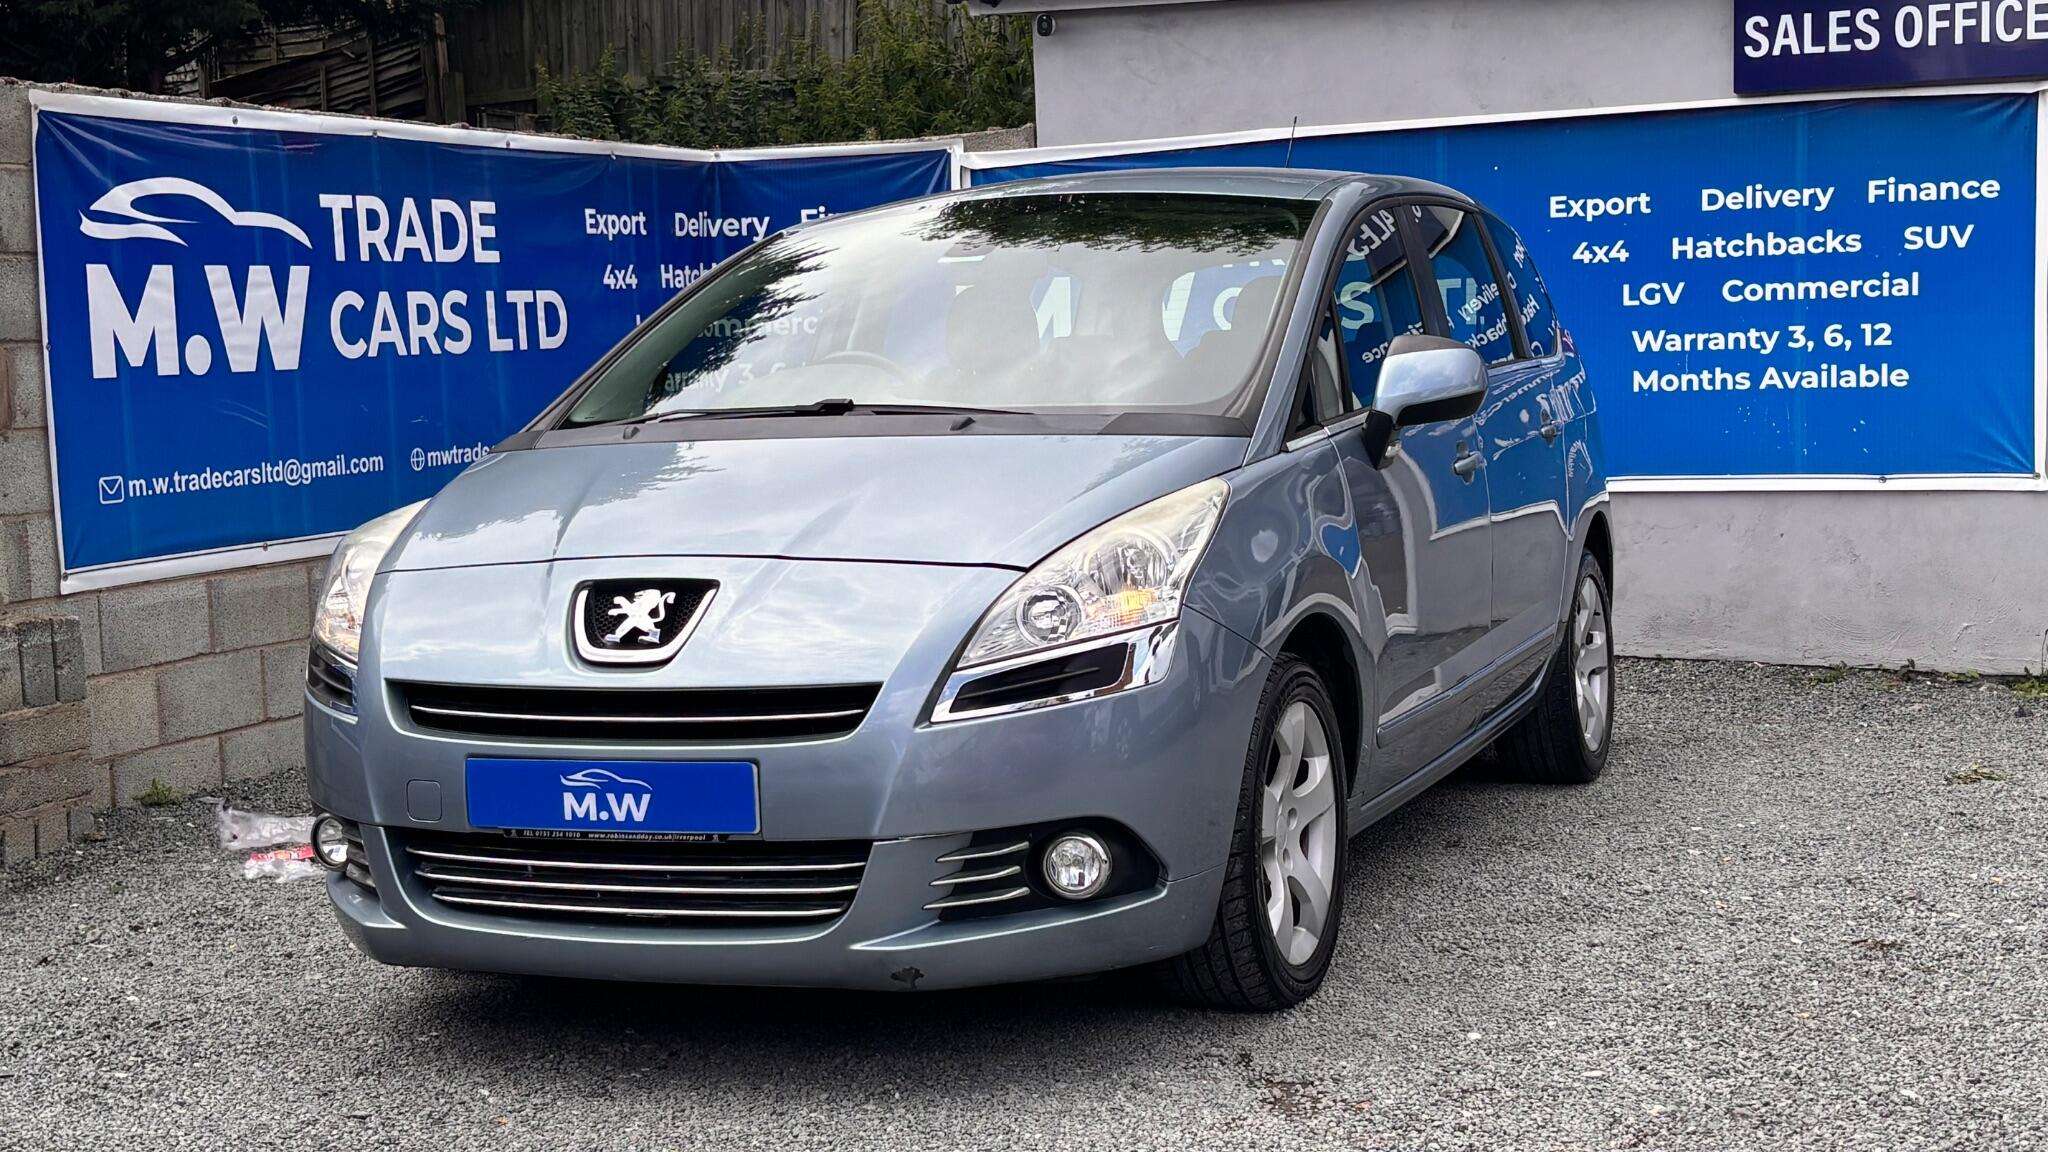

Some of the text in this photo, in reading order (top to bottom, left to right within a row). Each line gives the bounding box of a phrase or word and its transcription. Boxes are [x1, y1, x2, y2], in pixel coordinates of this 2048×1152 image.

[1743, 0, 2048, 58] SALES OFFICE
[1549, 176, 2001, 222] Export Delivery Finance
[318, 193, 501, 263] TRADE
[584, 208, 647, 241] Export
[674, 211, 770, 241] Delivery
[1572, 224, 1975, 264] 4x4 Hatchbacks SUV
[603, 264, 638, 290] 4x4
[1622, 272, 1919, 306] LGV Commercial
[85, 263, 311, 379] M.W
[330, 289, 568, 359] CARS LTD
[1631, 322, 1893, 355] Warranty 3, 6, 12
[1633, 363, 1910, 393] Months Available
[427, 442, 495, 467] mwtrade
[128, 453, 384, 498] m.w.tradecarsltd@gmail.com
[563, 792, 651, 822] M.W
